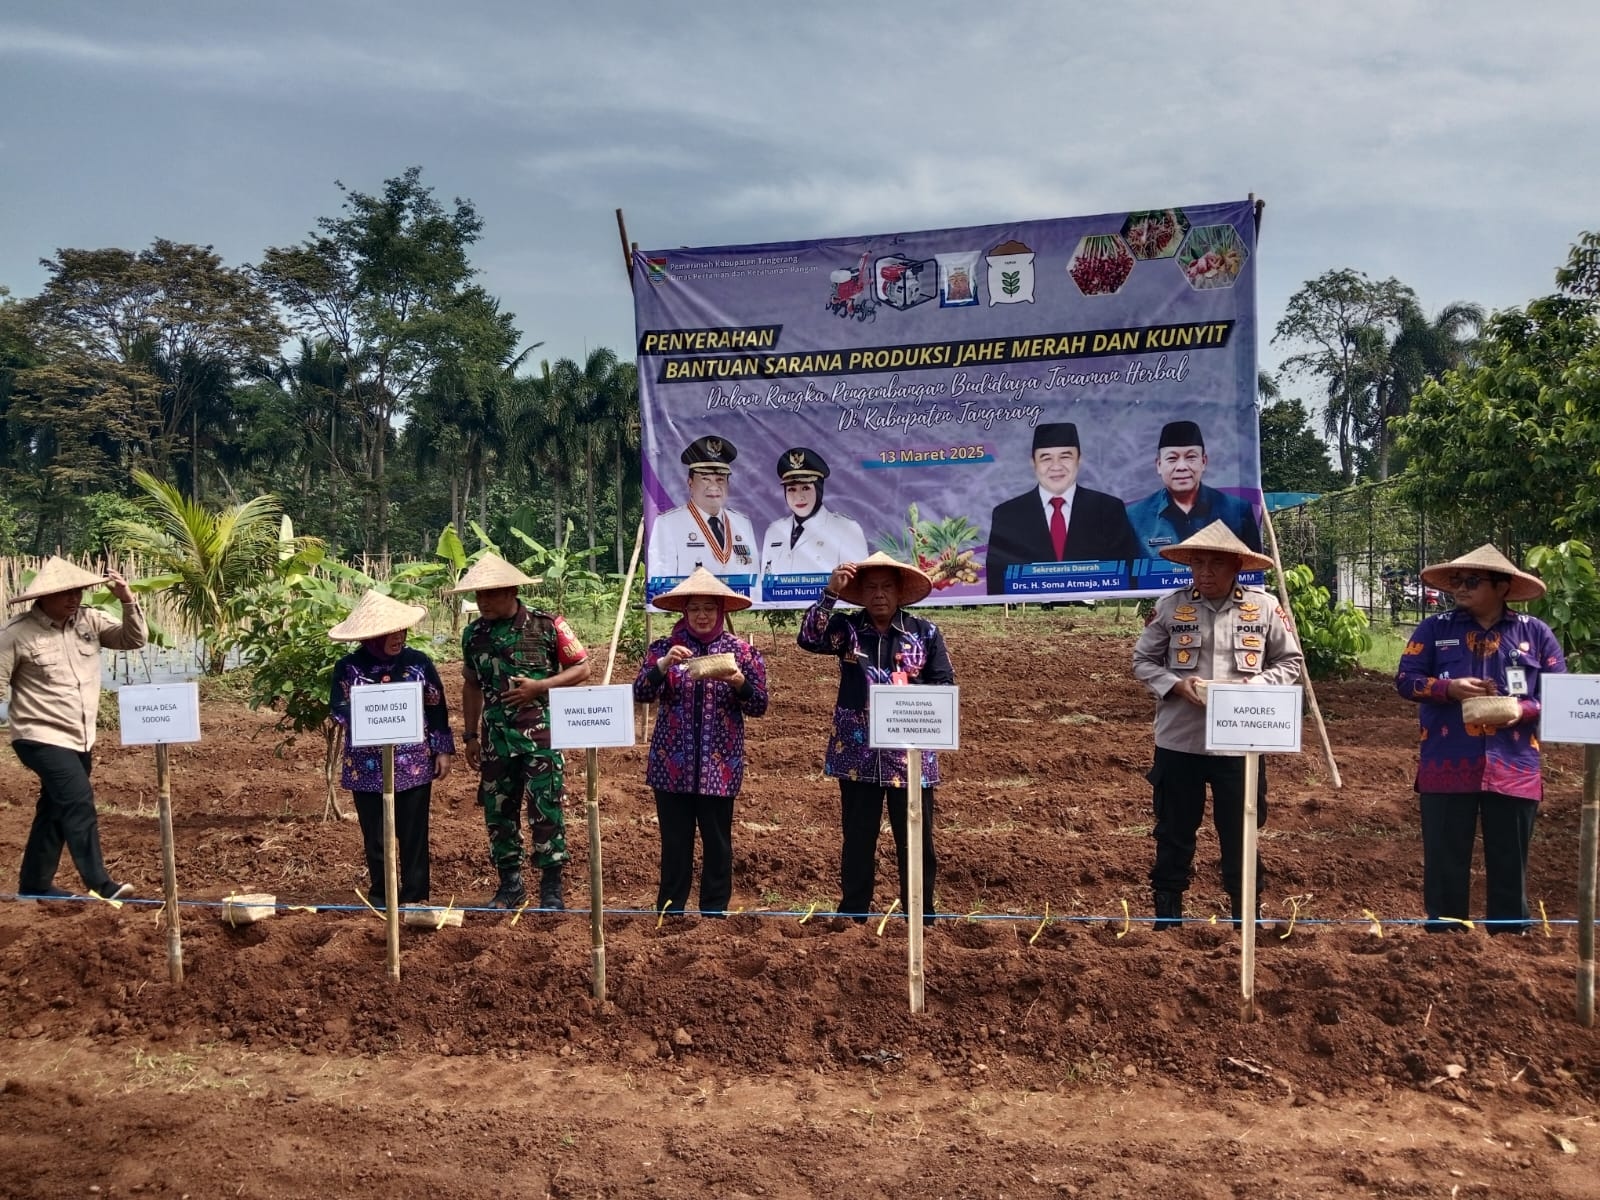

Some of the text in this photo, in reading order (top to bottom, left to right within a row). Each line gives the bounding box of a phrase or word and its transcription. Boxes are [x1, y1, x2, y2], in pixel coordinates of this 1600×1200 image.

[715, 258, 756, 268] Kabupaten
[757, 256, 799, 265] Tangerang
[645, 329, 774, 351] PENYERAHAN
[666, 324, 1228, 379] BANTUAN SARANA PRODUKSI JAHE MERAH DAN KUNYIT
[706, 355, 1190, 412] Dalam Rangka Pengembangan Budidaya Tanaman Herbal
[838, 401, 1044, 434] Di Kabupaten Tangerang
[879, 445, 985, 464] 13 Maret 2025
[1032, 564, 1100, 574] Sekretaris Daerah
[801, 575, 824, 585] Bupati
[1012, 578, 1120, 590] Drs. H. Soma Atmaja, M.Si
[1161, 574, 1255, 586] Ir. Asep MM
[772, 588, 793, 596] Intan
[794, 587, 817, 595] Nurul
[1236, 625, 1264, 633] POLRI
[1577, 697, 1600, 706] CAM
[134, 703, 177, 712] KEPALA DESA
[364, 702, 408, 712] KODIM 0510
[564, 706, 613, 715] WAKIL BUPATI
[1233, 706, 1276, 716] KAPOLRES
[142, 715, 171, 723] SODONG
[367, 715, 406, 725] TIGARAKSA
[567, 718, 611, 727] TANGERANG
[1216, 720, 1291, 730] KOTA TANGERANG
